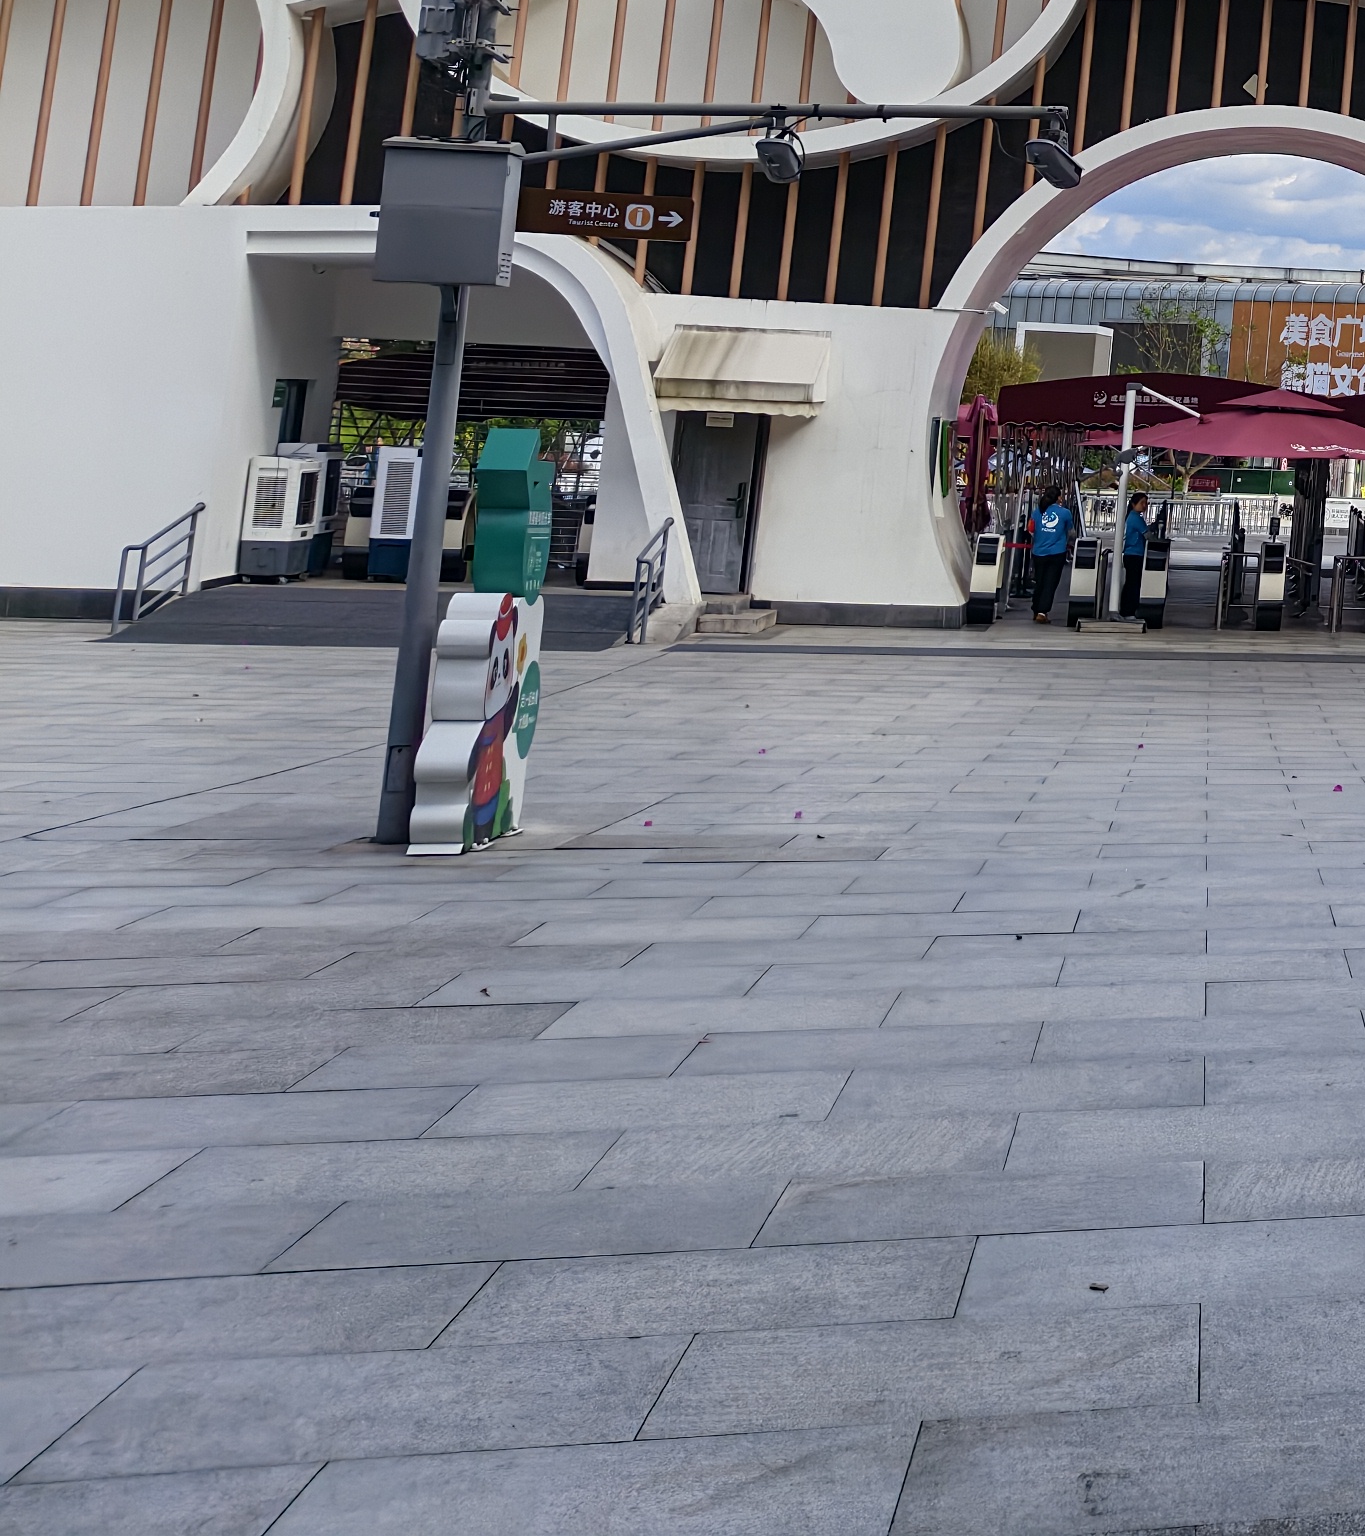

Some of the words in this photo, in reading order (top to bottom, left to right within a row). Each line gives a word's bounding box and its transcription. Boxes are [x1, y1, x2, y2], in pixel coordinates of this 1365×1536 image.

[549, 199, 620, 219] 游客中心
[568, 218, 593, 226] Tourist
[594, 220, 619, 228] Centre
